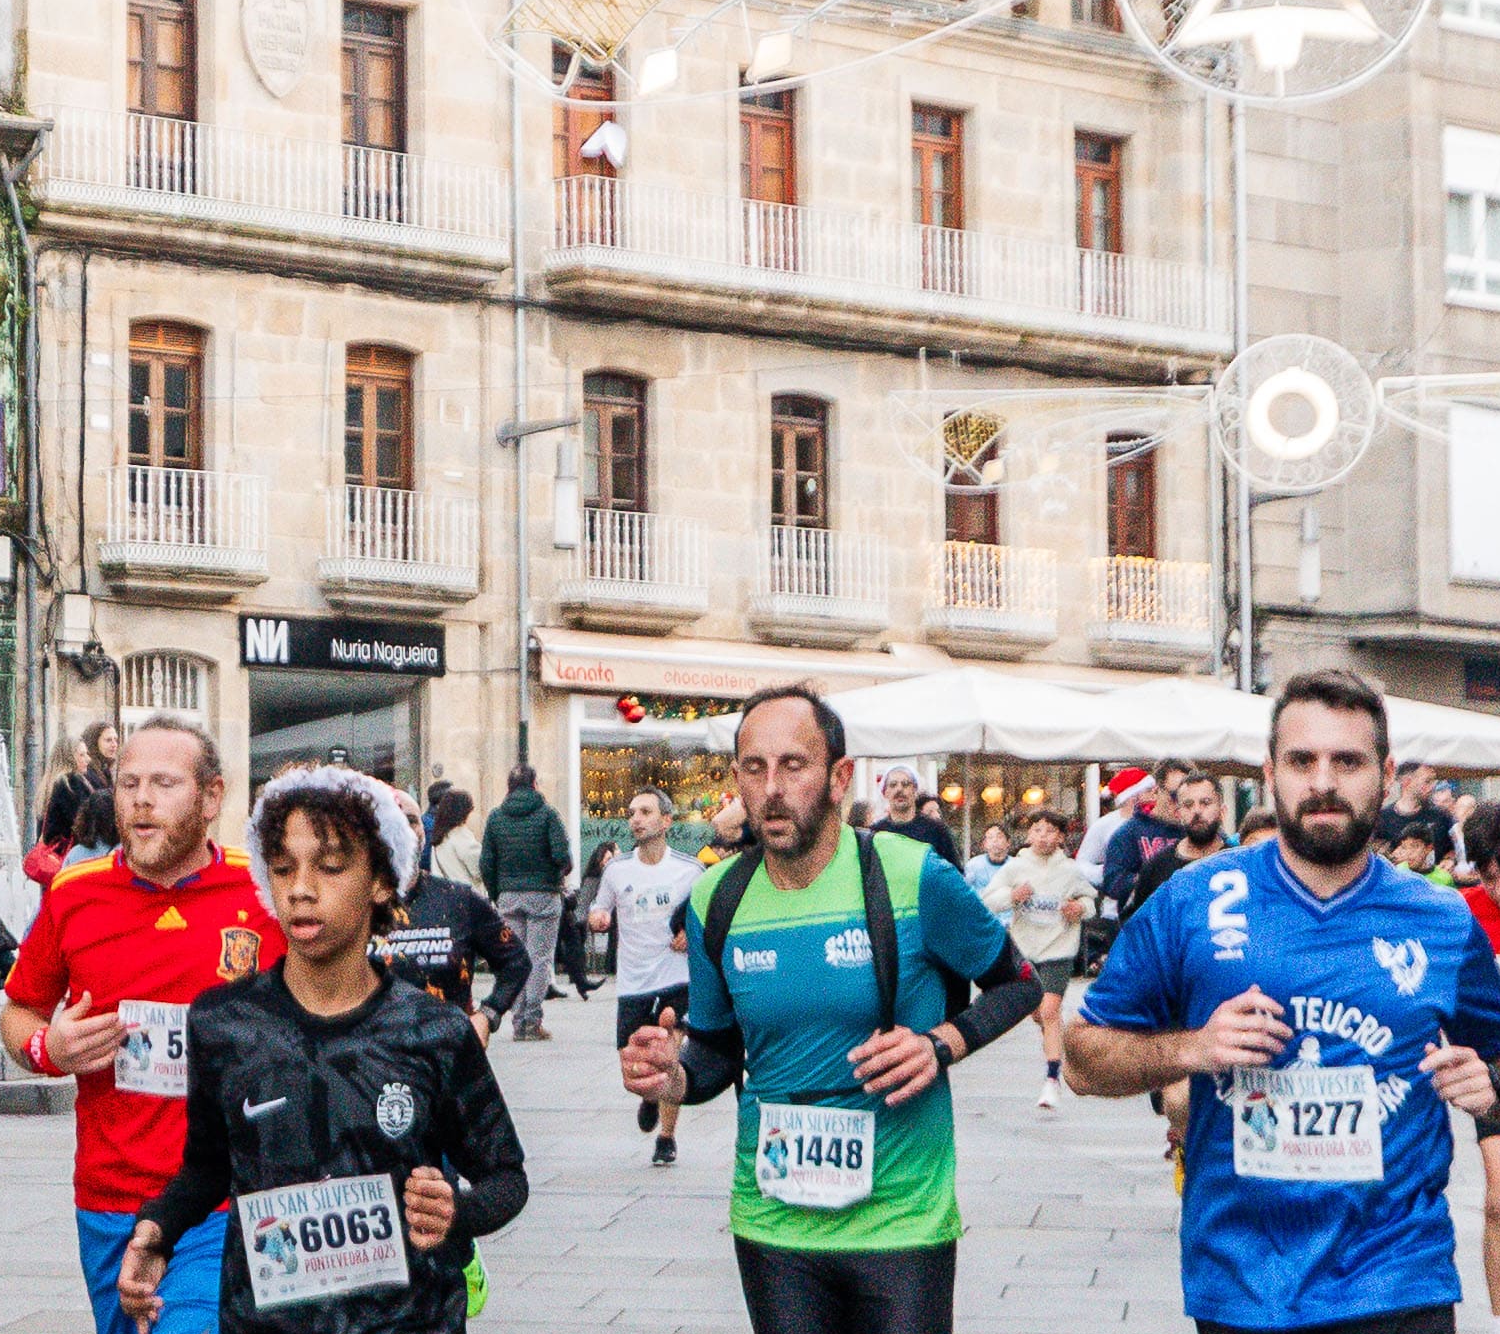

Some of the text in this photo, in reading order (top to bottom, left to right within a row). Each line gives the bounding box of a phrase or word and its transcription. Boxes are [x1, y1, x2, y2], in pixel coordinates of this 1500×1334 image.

[331, 637, 440, 668] Nuria Nogueira
[1207, 869, 1249, 931] 2
[743, 949, 778, 967] ence
[143, 1008, 165, 1026] SAN
[1289, 995, 1394, 1057] TEUCRO
[166, 1028, 190, 1060] 5
[1298, 1071, 1368, 1098] SILVESTRE
[784, 1112, 803, 1131] SAN
[807, 1113, 867, 1135] SILVESTRE
[1288, 1100, 1364, 1137] 1277
[794, 1134, 864, 1170] 1448
[277, 1190, 309, 1218] SAN
[311, 1179, 386, 1212] SILVESTRE
[299, 1203, 394, 1253] 6063
[303, 1241, 397, 1275] PONTEVEDRA 2025
